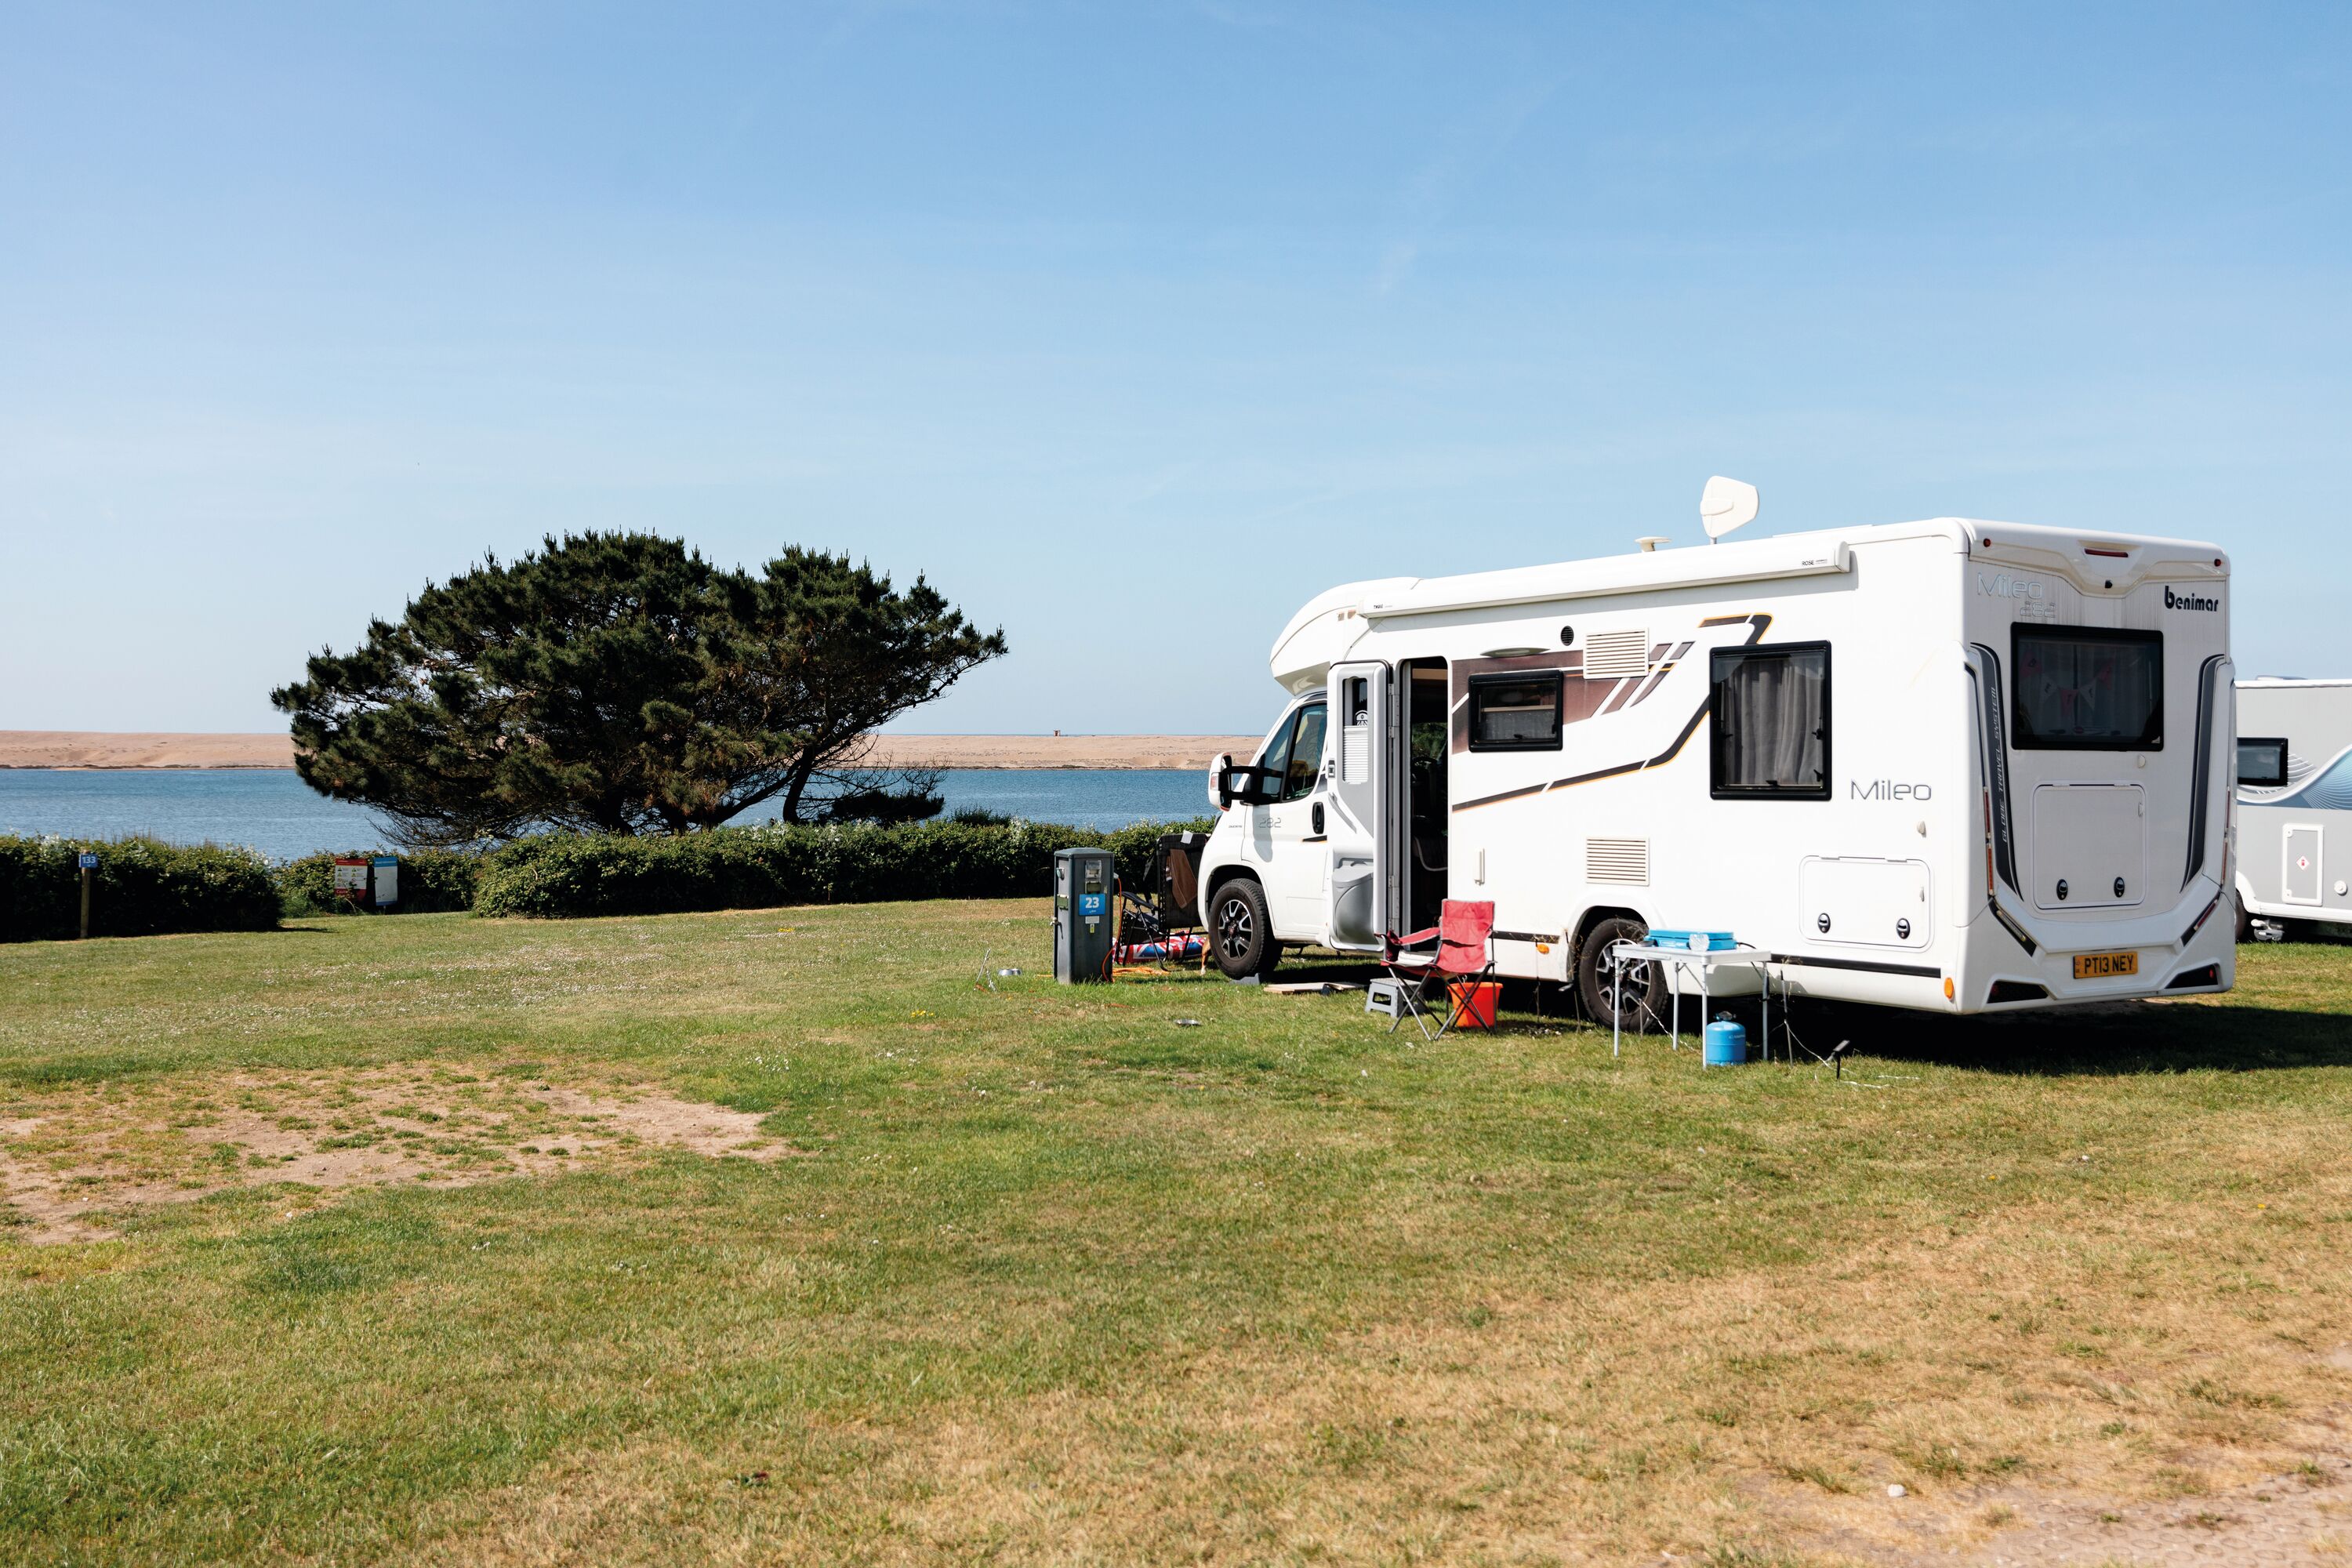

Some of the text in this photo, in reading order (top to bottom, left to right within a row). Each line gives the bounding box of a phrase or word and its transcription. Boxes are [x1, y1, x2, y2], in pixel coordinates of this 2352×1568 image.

[1977, 572, 2042, 599] Mileo
[2165, 586, 2219, 612] benimar
[2020, 601, 2056, 618] 282
[1994, 746, 2004, 793] TRAVEL
[1851, 779, 1932, 800] Mileo
[1258, 817, 1282, 829] 282
[1085, 897, 1099, 909] 23
[2085, 954, 2133, 974] PT13 NEY
